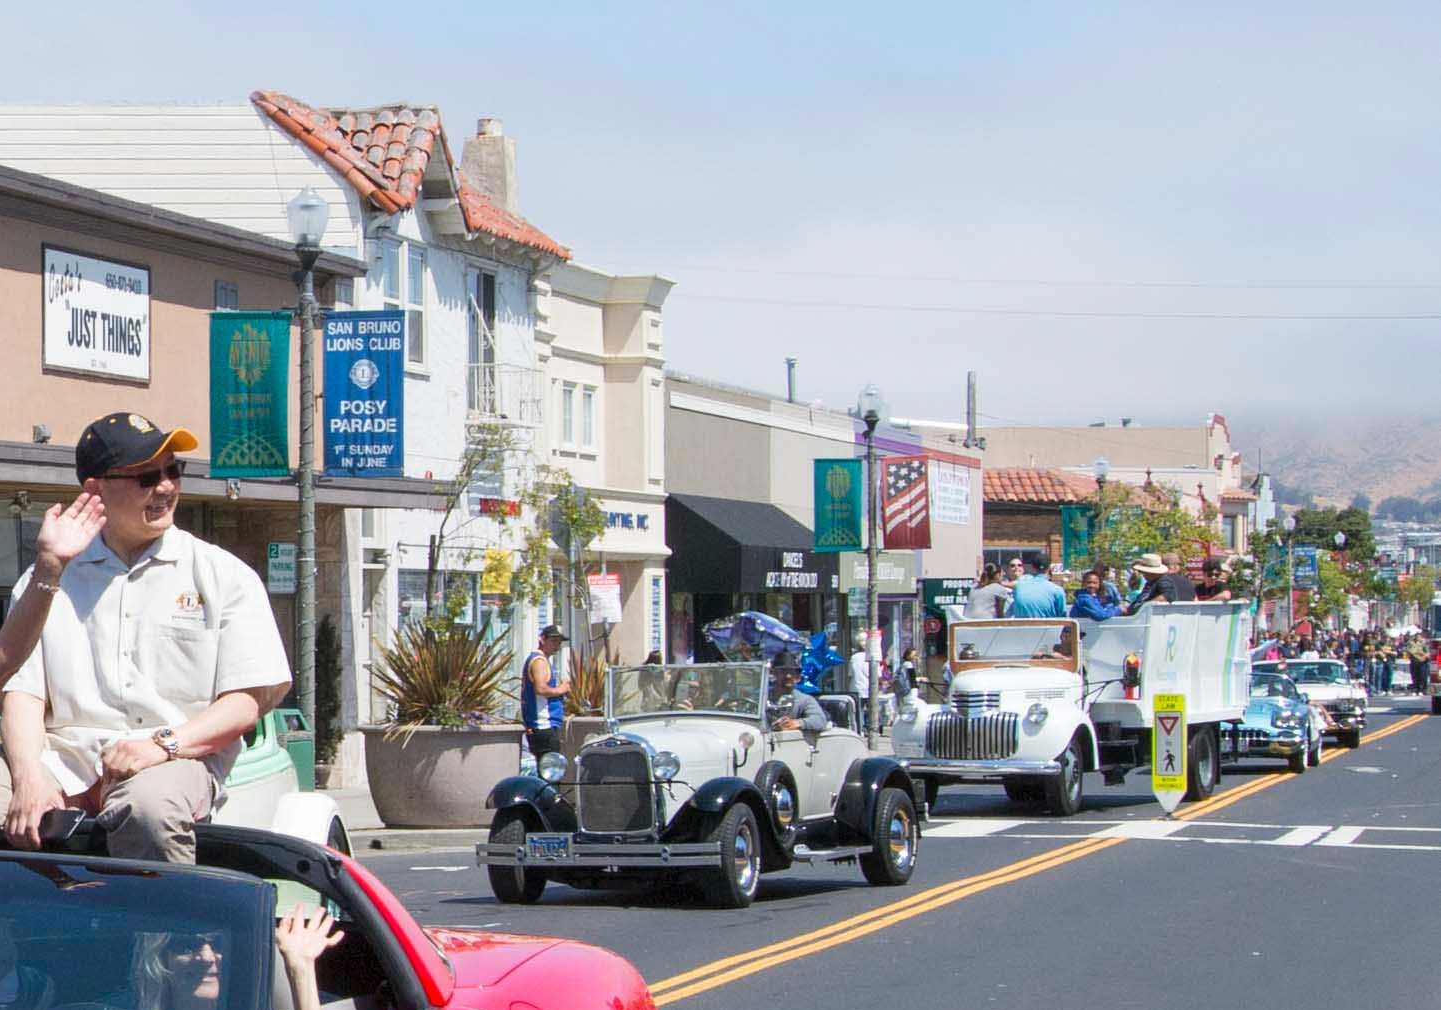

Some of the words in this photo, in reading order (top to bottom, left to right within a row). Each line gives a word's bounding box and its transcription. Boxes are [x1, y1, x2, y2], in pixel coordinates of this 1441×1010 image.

[327, 322, 353, 336] SAN
[358, 320, 401, 335] BRUNO
[326, 338, 364, 352] LIONS
[369, 337, 401, 352] CLUB
[340, 400, 387, 415] POSY
[330, 418, 397, 433] PARADE
[349, 444, 394, 455] SUNDAY
[341, 457, 353, 467] IN
[357, 457, 387, 468] JUNE
[270, 545, 279, 557] 2
